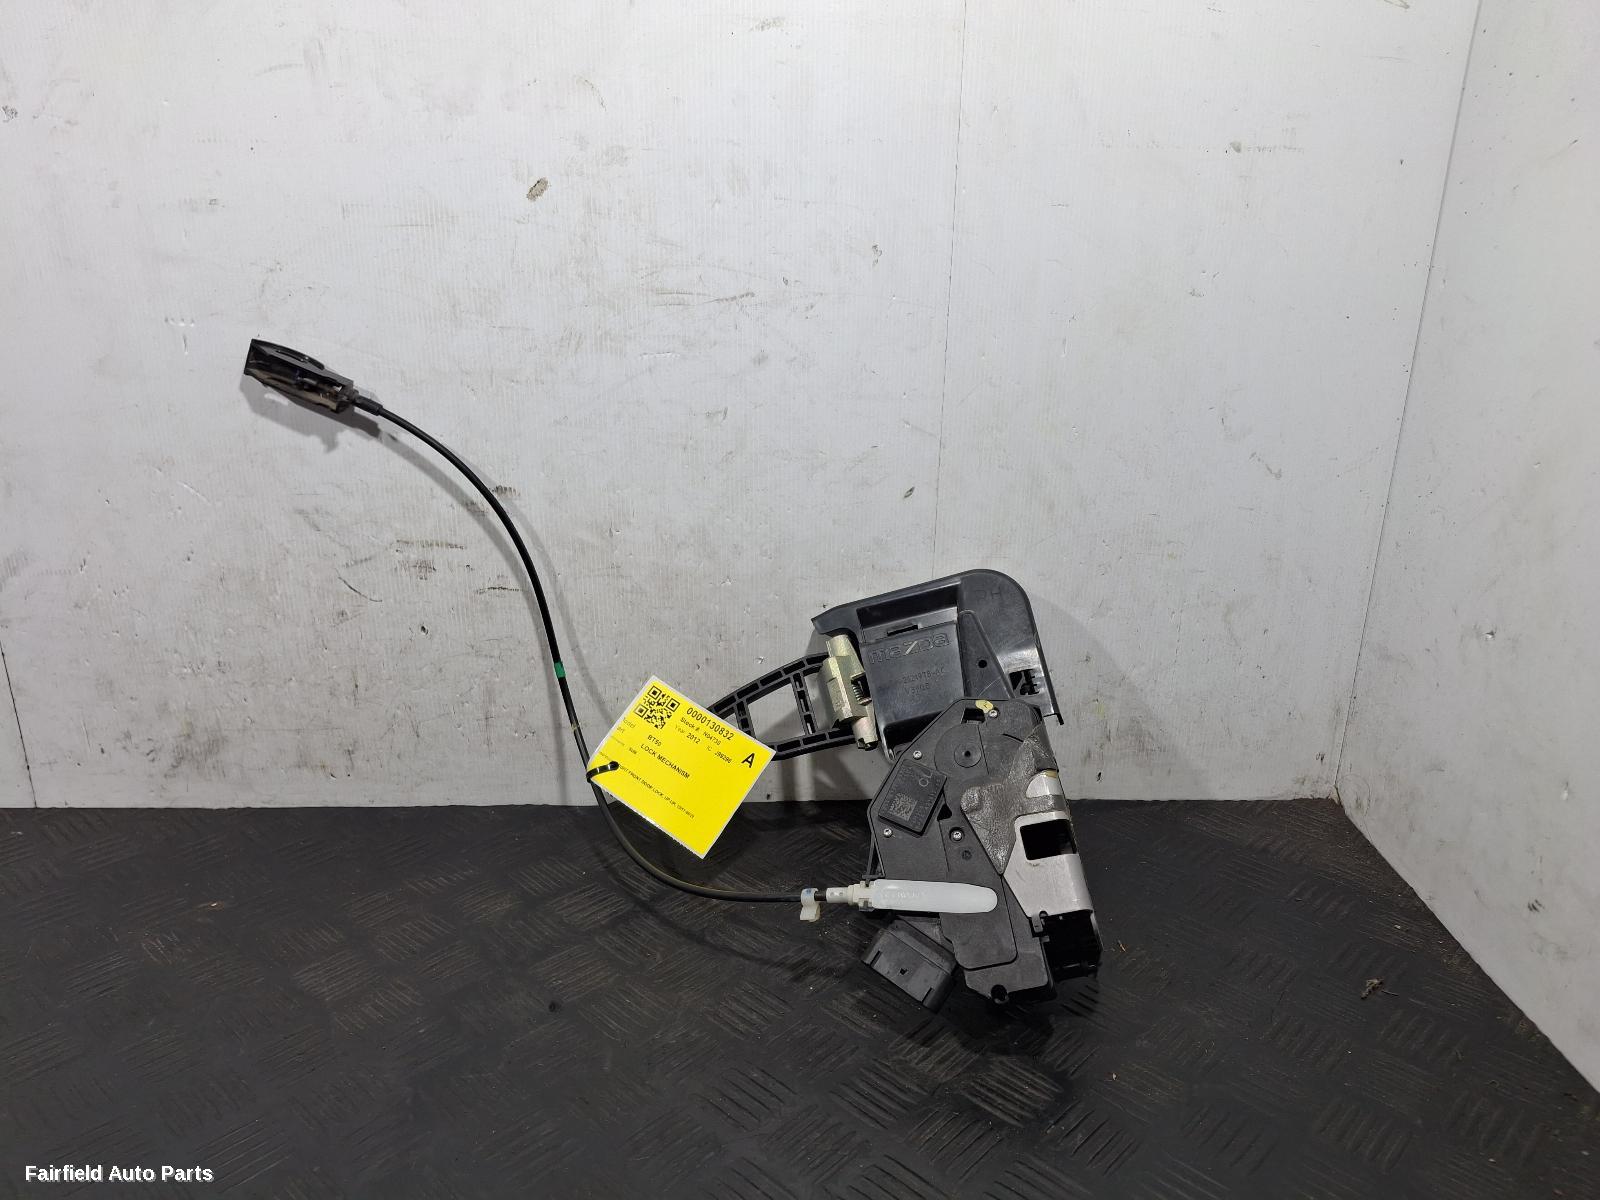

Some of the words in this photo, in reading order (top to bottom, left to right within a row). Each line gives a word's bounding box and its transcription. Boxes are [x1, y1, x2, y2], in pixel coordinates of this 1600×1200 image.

[680, 716, 695, 729] Stock
[686, 705, 734, 741] 0000130832
[646, 734, 662, 746] BT50
[686, 732, 701, 744] 2012
[640, 742, 657, 757] LOCK
[655, 754, 690, 779] MECHANISM
[741, 752, 756, 768] A
